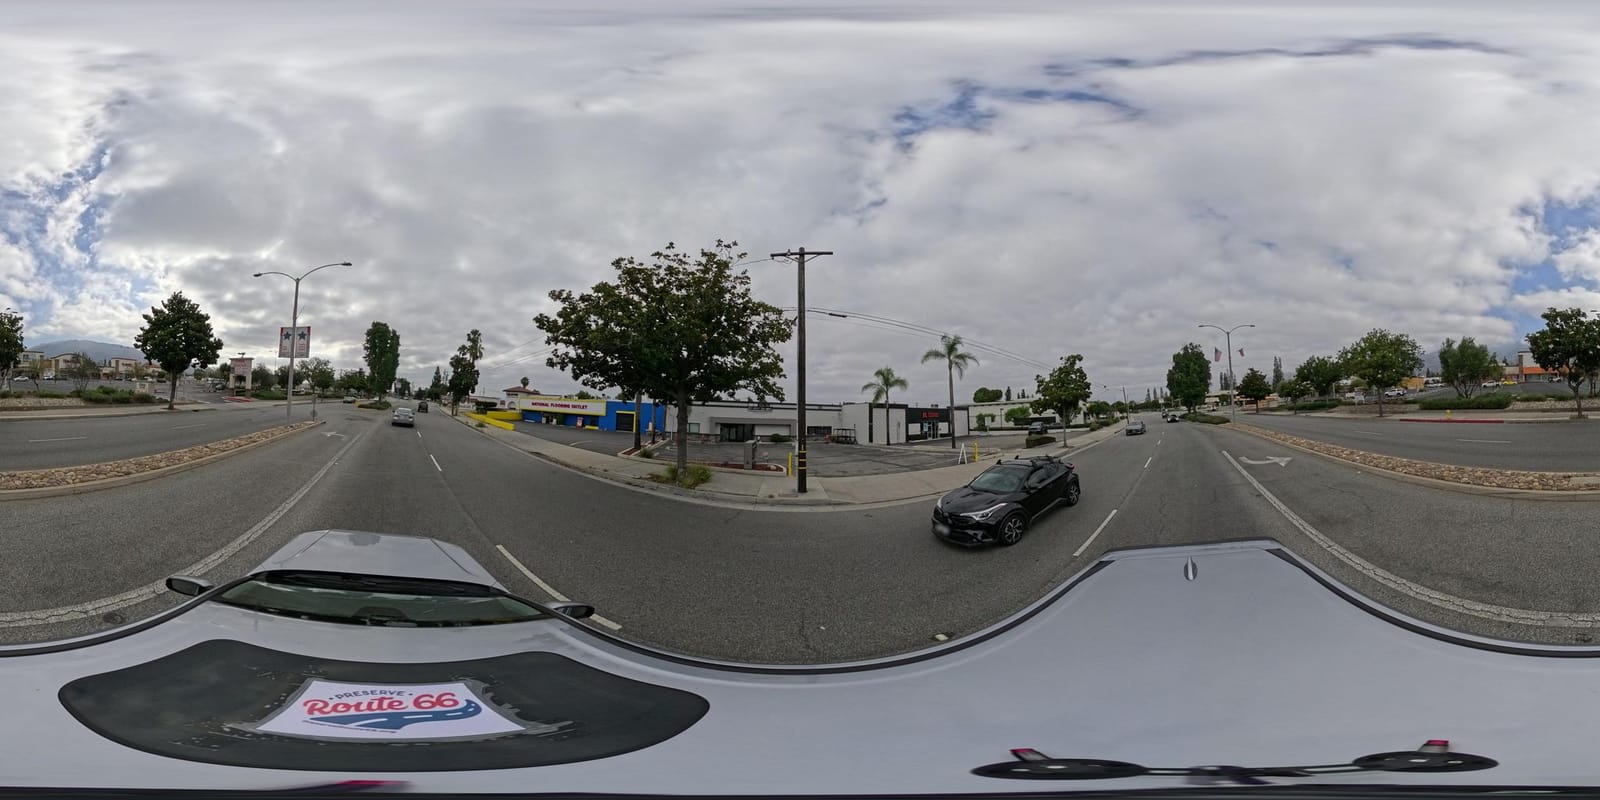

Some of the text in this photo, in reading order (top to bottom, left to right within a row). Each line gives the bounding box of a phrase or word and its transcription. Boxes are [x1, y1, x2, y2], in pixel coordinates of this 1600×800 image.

[334, 690, 405, 700] PRESERVE
[303, 692, 460, 716] Route 66
